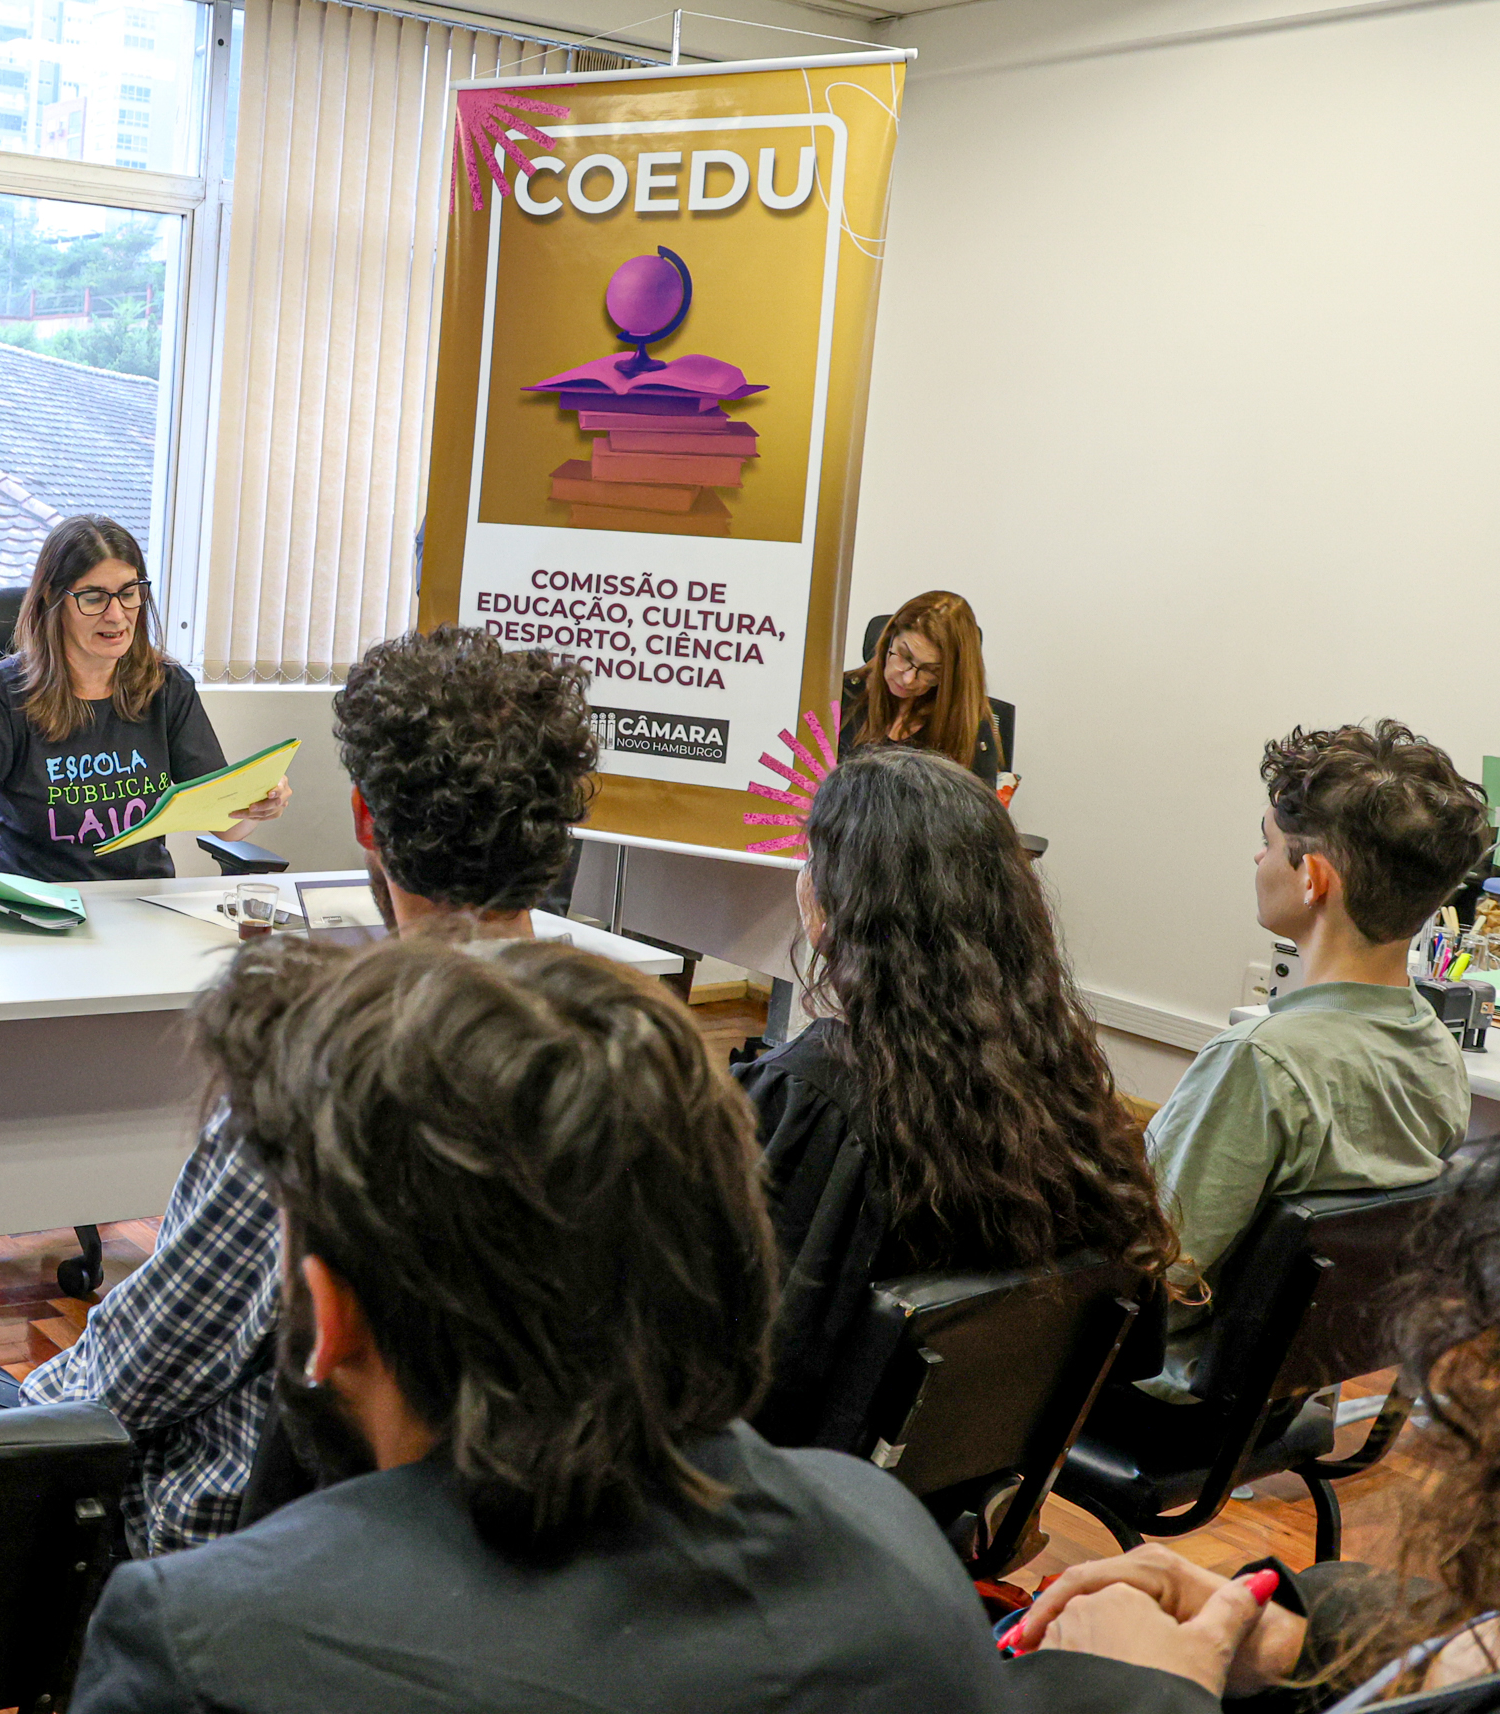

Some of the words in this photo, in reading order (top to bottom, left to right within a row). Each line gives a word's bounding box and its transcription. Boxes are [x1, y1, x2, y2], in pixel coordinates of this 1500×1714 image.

[514, 145, 816, 216] COEDU
[531, 569, 678, 599] COMISSÃO
[687, 581, 727, 603] DE
[477, 591, 634, 628] EDUCAÇÃO,
[642, 605, 786, 641] CULTURA,
[485, 619, 637, 656] DESPORTO,
[645, 631, 765, 664] CIÊNCIA
[617, 714, 724, 746] CÂMARA
[616, 737, 650, 750] NOVO
[652, 741, 723, 759] HAMBURGO
[46, 749, 148, 783] ESCOLA
[47, 776, 157, 805] PÚBLICA
[158, 772, 169, 791] &
